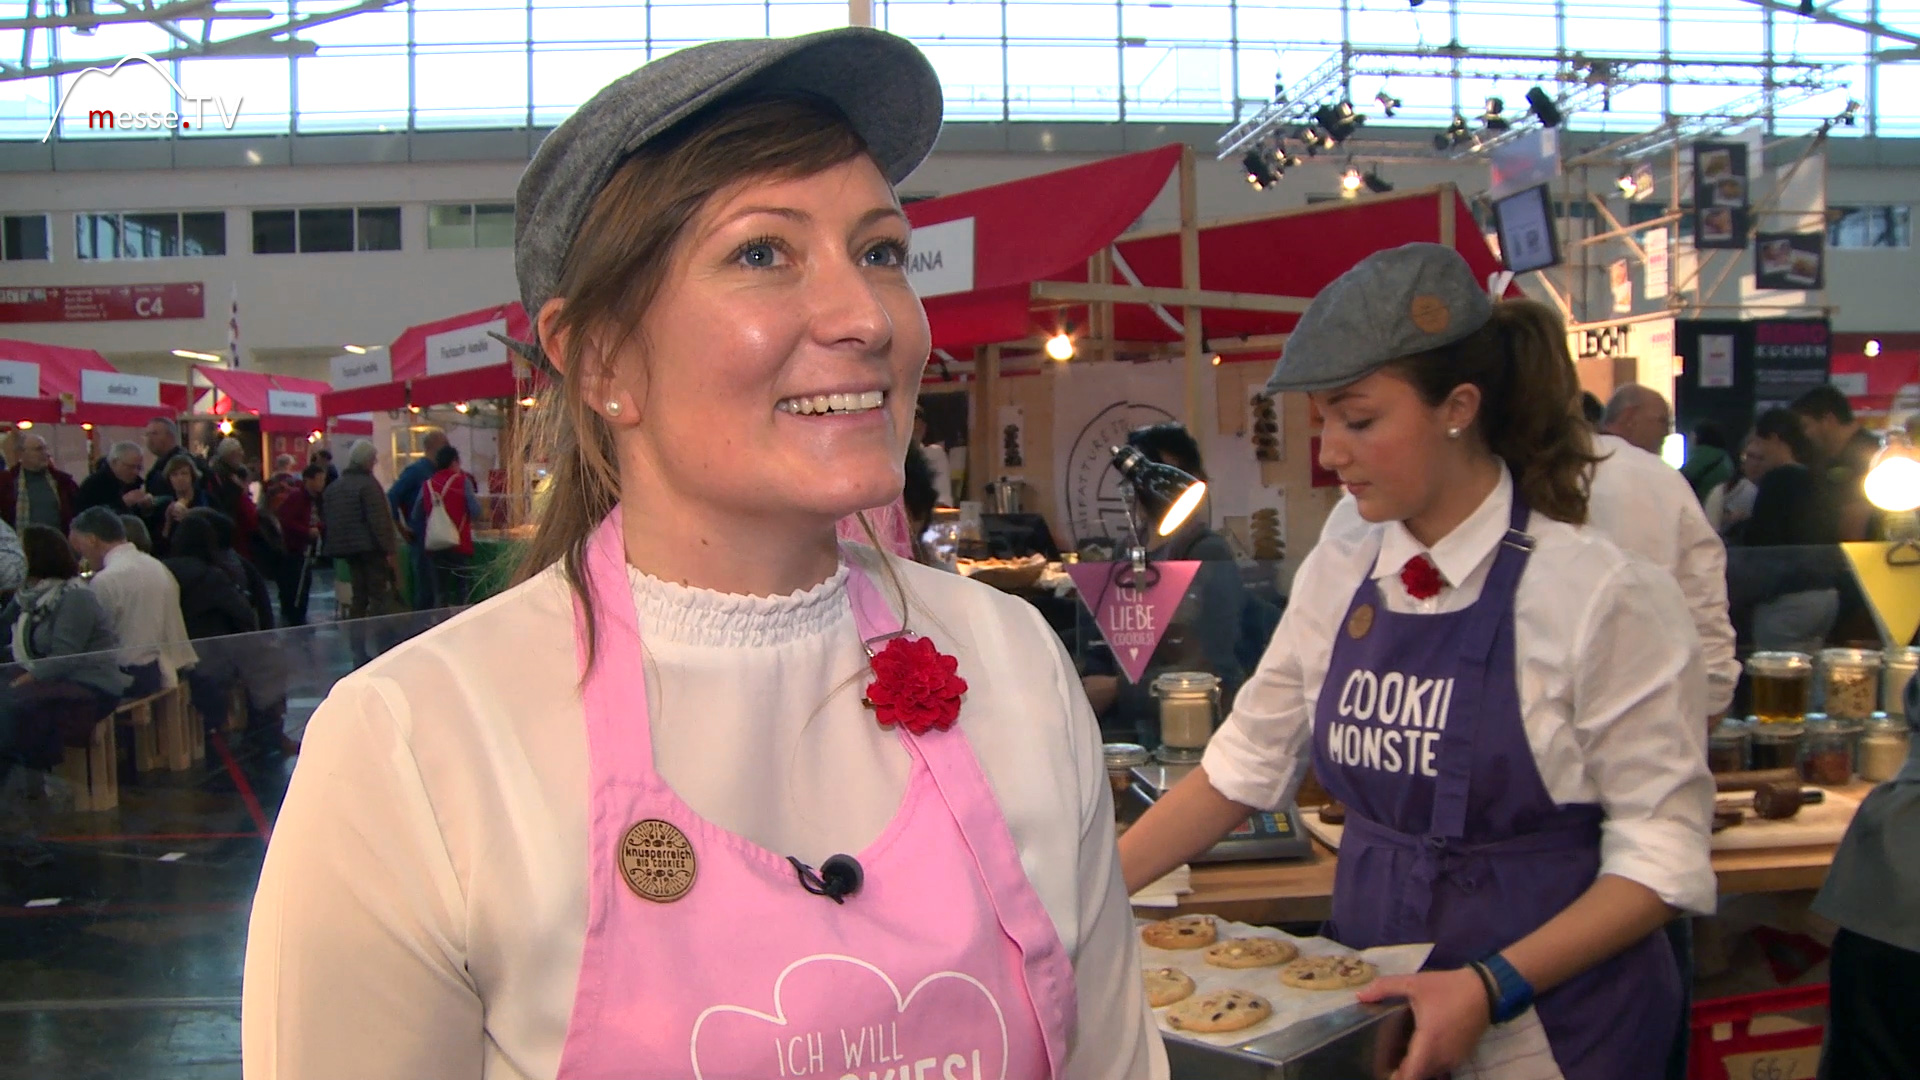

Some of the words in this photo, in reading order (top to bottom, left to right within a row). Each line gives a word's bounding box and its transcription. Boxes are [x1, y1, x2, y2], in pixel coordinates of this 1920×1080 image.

[135, 297, 163, 317] C4
[1110, 604, 1155, 631] LIEBE
[625, 846, 692, 861] knusperreich
[636, 858, 649, 868] BIO
[652, 859, 686, 869] COOKIES
[775, 1031, 824, 1077] ICH
[840, 1021, 904, 1070] WILL
